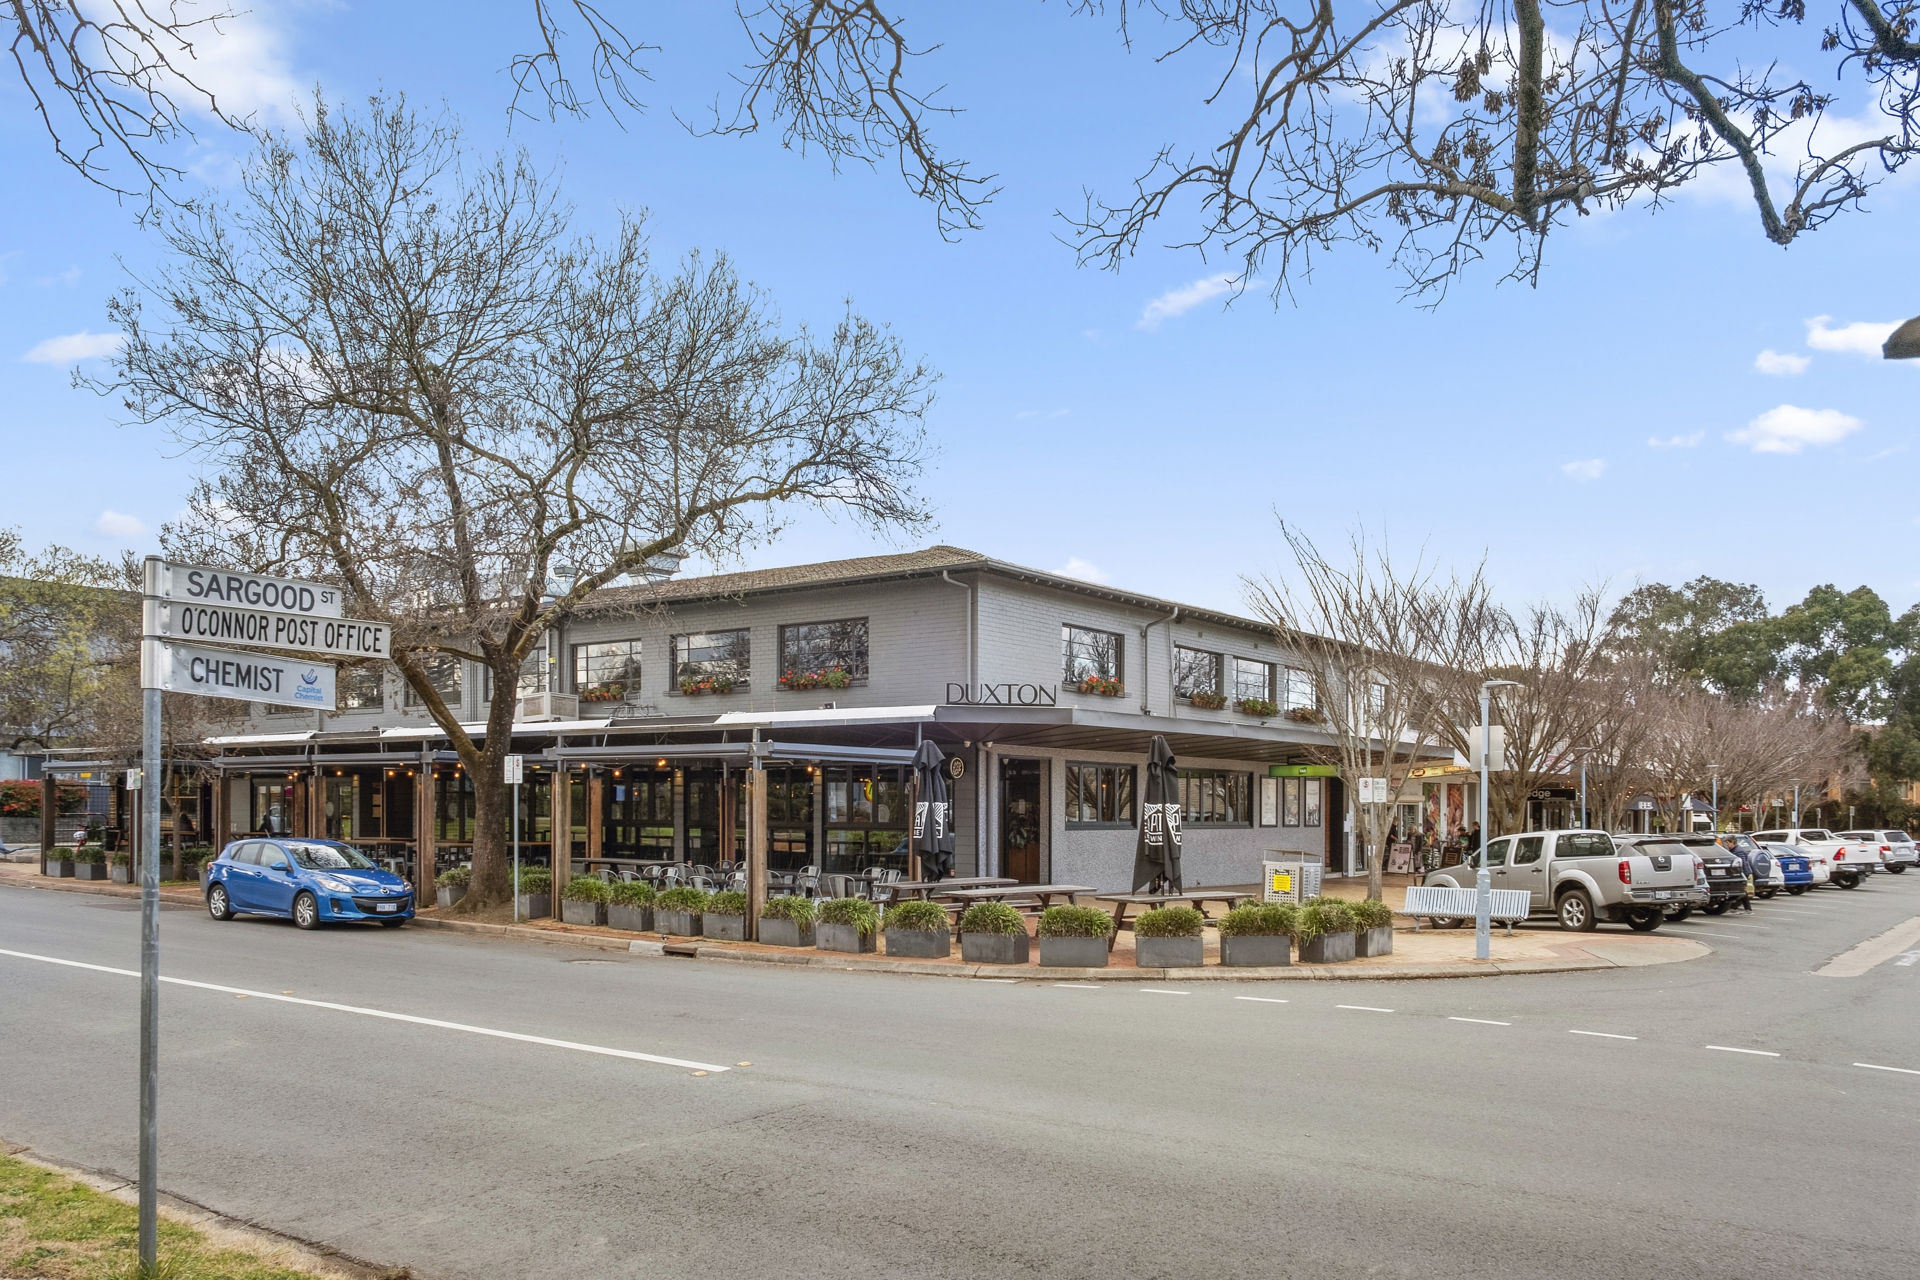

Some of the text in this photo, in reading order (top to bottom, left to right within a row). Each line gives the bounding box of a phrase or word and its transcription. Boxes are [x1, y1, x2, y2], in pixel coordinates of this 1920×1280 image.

[186, 571, 336, 612] SARGOOD ST
[182, 607, 383, 653] O'CONNOR POST OFFICE
[190, 656, 284, 693] CHEMIST
[296, 685, 322, 694] Capital
[294, 692, 324, 701] Chemist
[946, 682, 1057, 705] DUXTON
